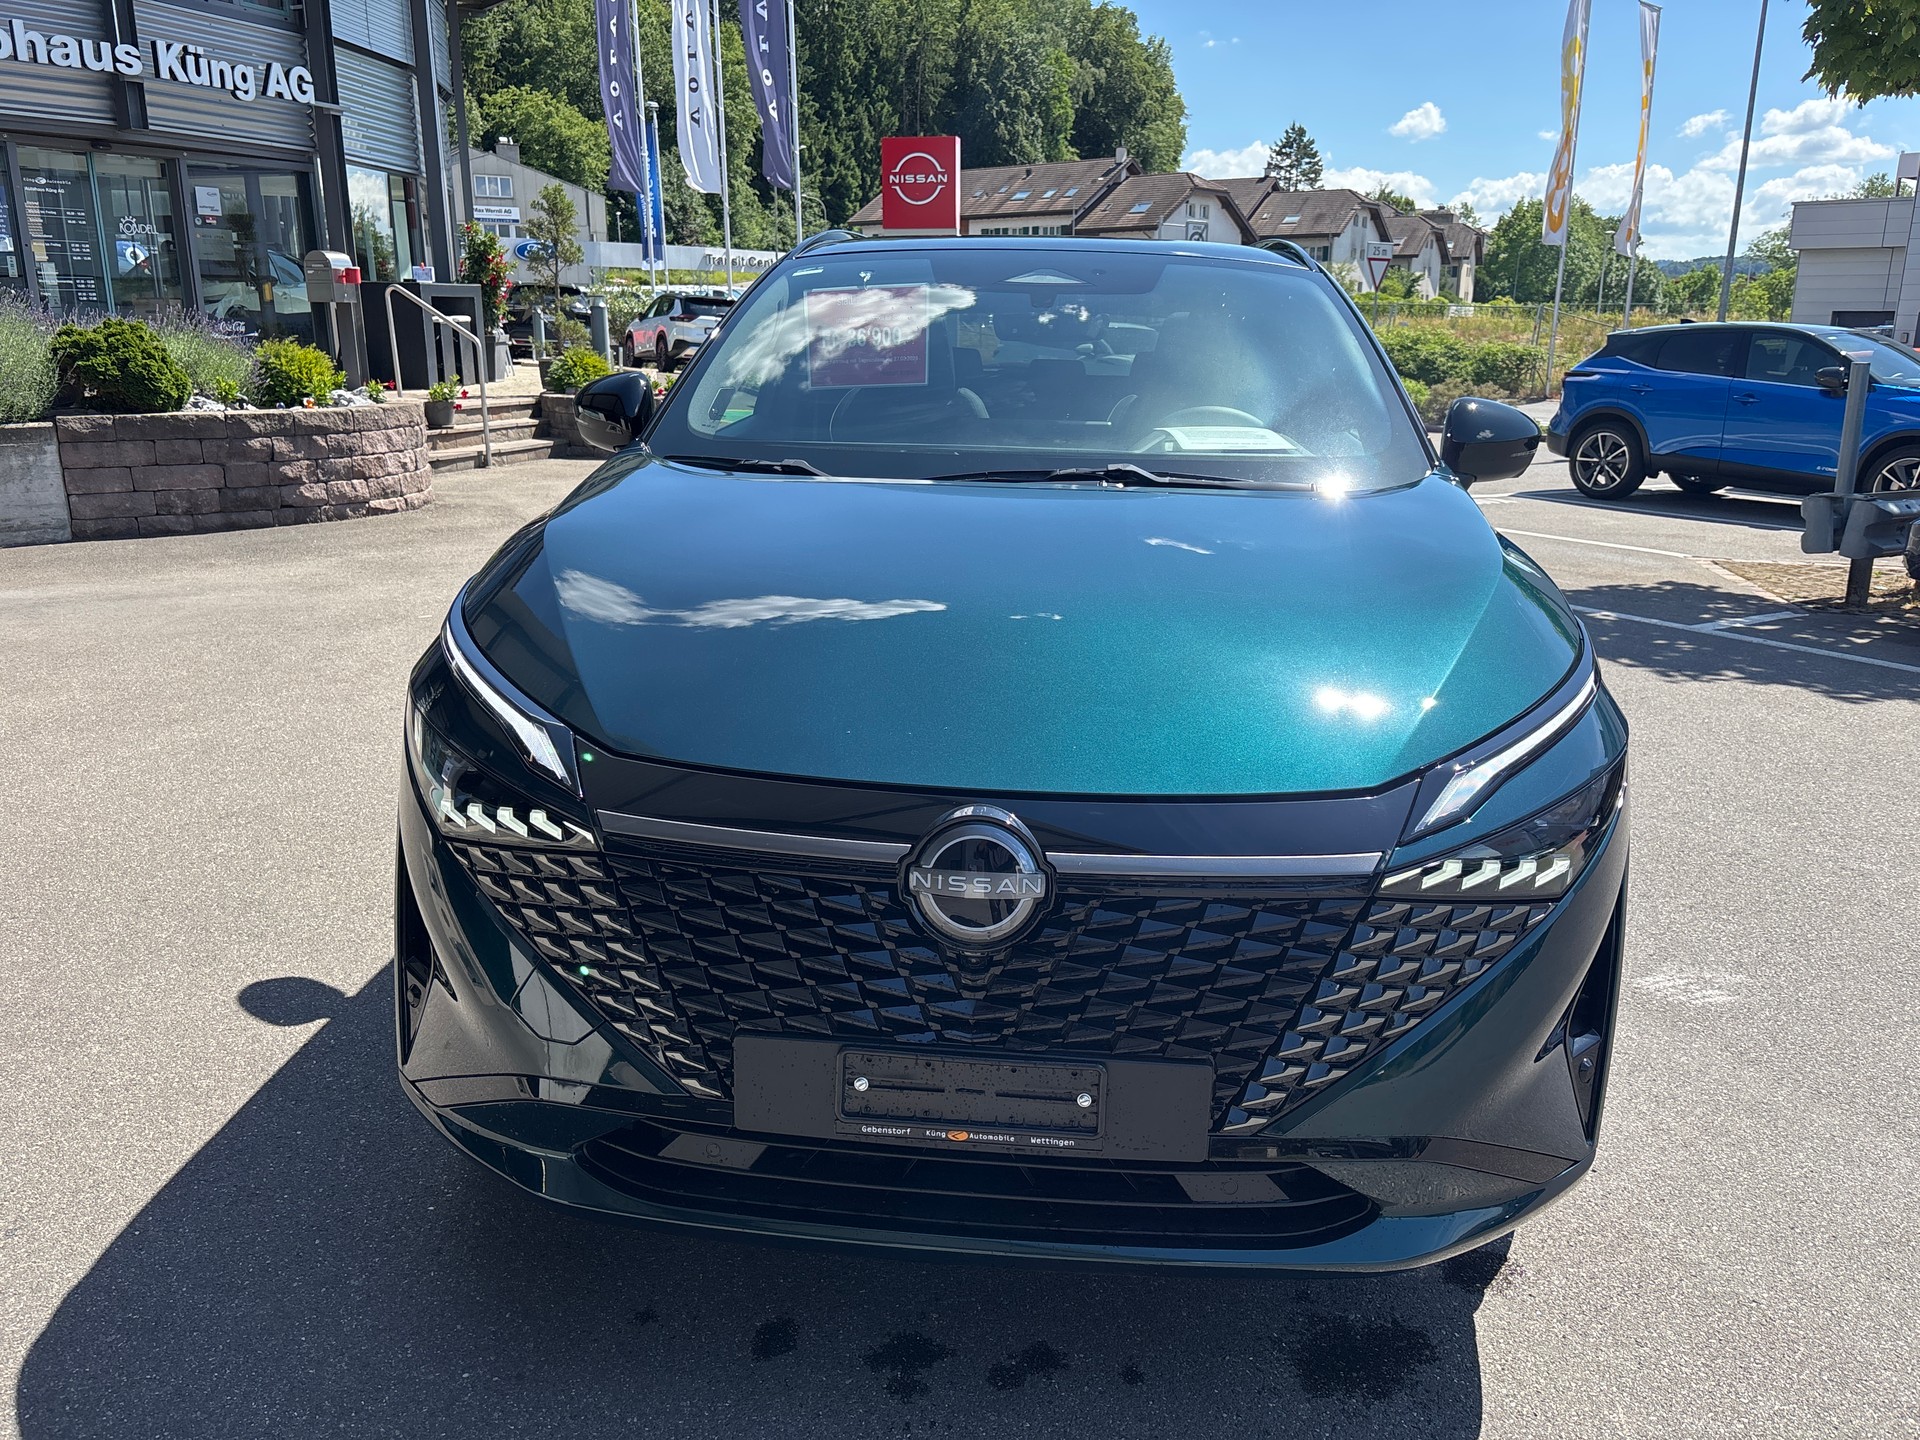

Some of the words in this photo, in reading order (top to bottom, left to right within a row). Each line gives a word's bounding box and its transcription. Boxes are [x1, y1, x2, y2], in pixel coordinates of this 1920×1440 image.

[153, 40, 256, 101] Küng
[264, 62, 316, 104] AG
[889, 174, 948, 184] NISSAN
[1373, 246, 1381, 256] 25
[912, 871, 1042, 894] NISSAN
[861, 1125, 911, 1135] Gebenstorf
[926, 1130, 946, 1138] Küng
[969, 1133, 1015, 1142] Automobile
[1030, 1136, 1075, 1147] Wettingen
